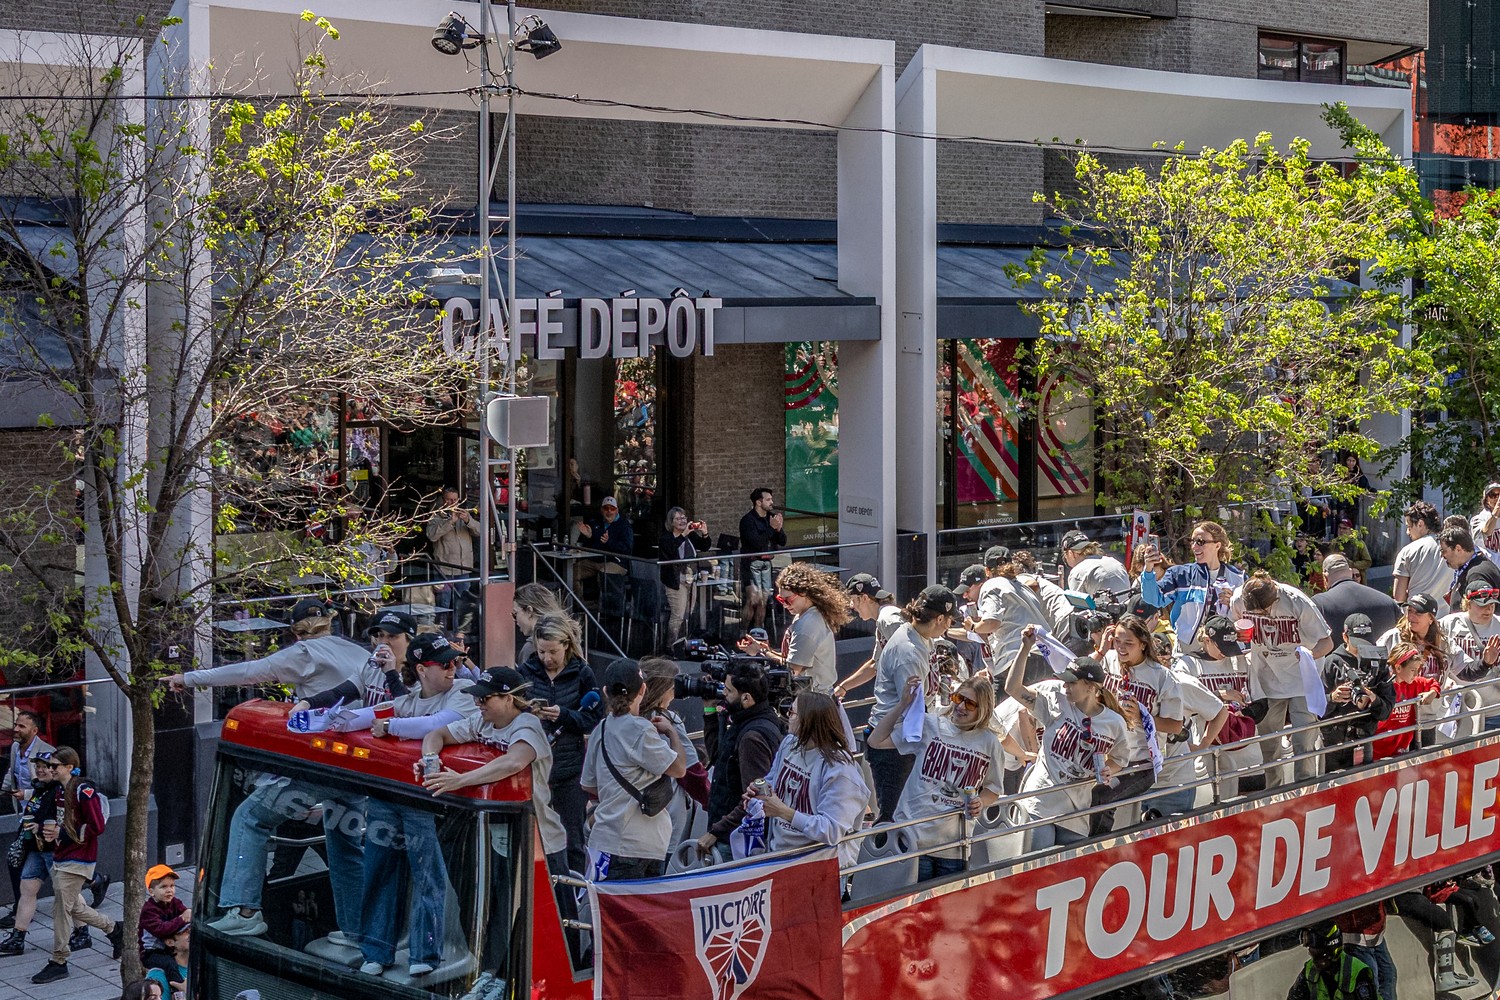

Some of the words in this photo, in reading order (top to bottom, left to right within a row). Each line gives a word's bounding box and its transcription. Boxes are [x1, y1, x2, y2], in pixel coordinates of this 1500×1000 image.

[442, 289, 565, 361] CAFÉ
[580, 287, 722, 358] DÉPÔT
[1036, 834, 1239, 979] TOUR
[1254, 803, 1337, 911] DE
[1355, 758, 1500, 876] VILLE
[700, 888, 768, 947] VICTOIRE
